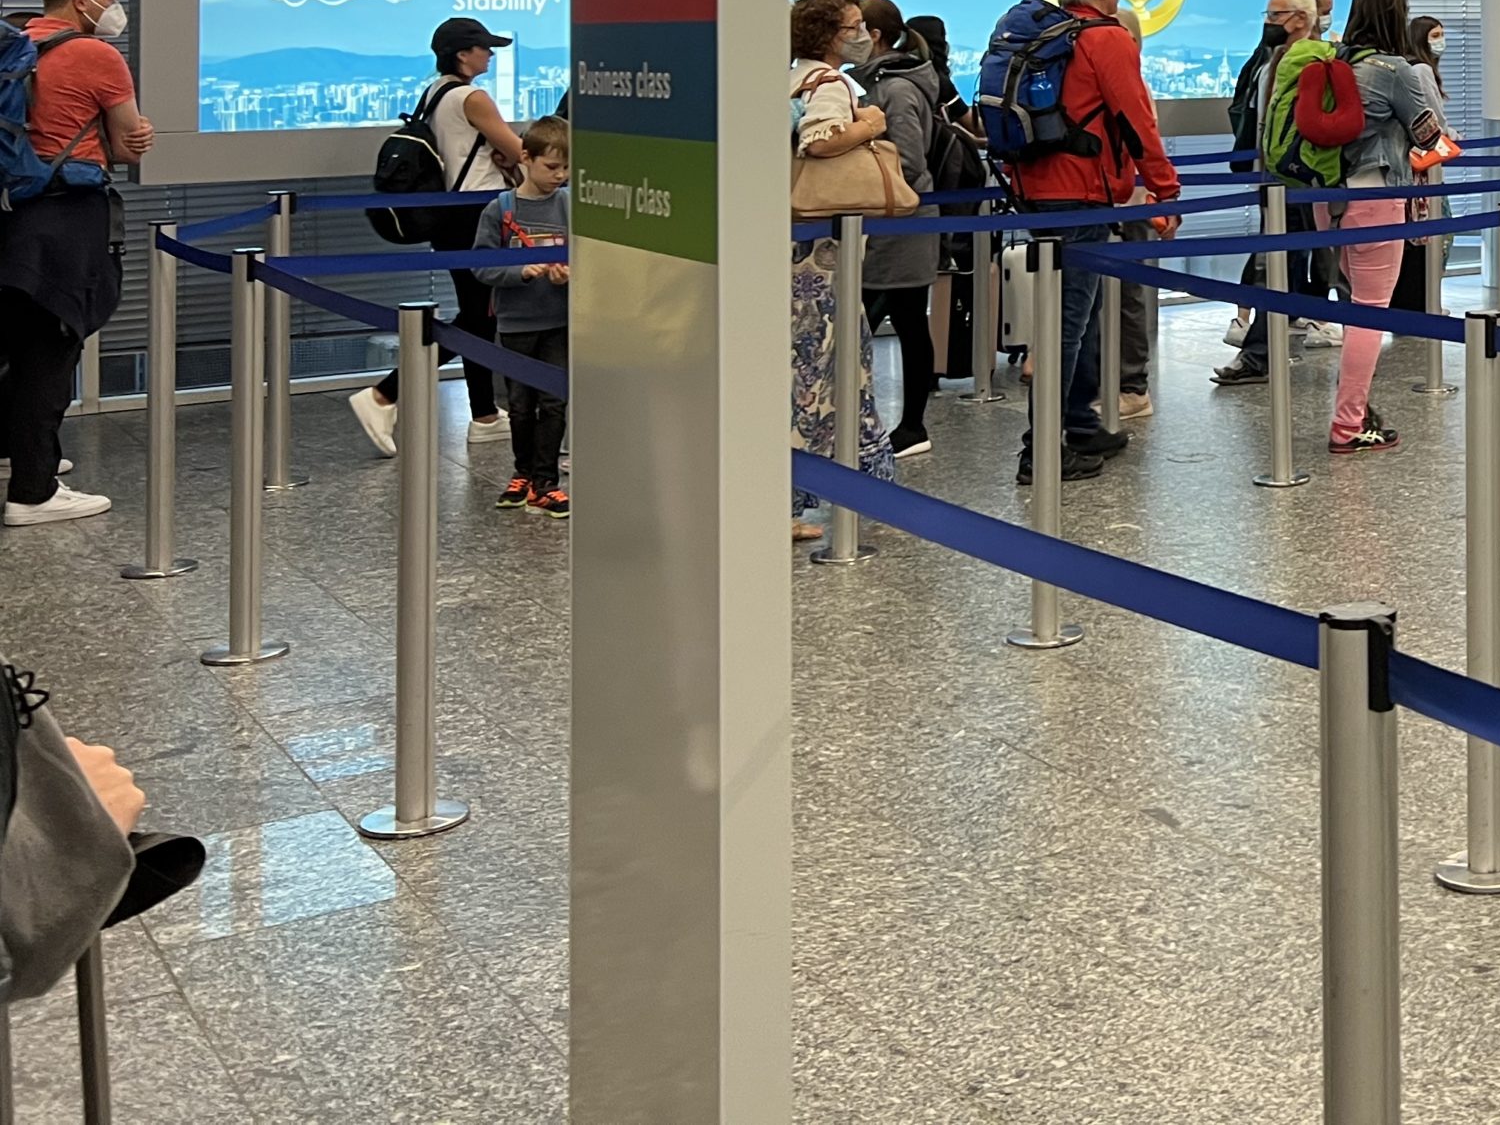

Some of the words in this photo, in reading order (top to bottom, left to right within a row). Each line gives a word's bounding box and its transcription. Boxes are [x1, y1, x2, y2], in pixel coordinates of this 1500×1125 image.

[578, 60, 633, 98] Business
[636, 61, 671, 99] class
[578, 168, 633, 220] Economy
[635, 177, 671, 218] class
